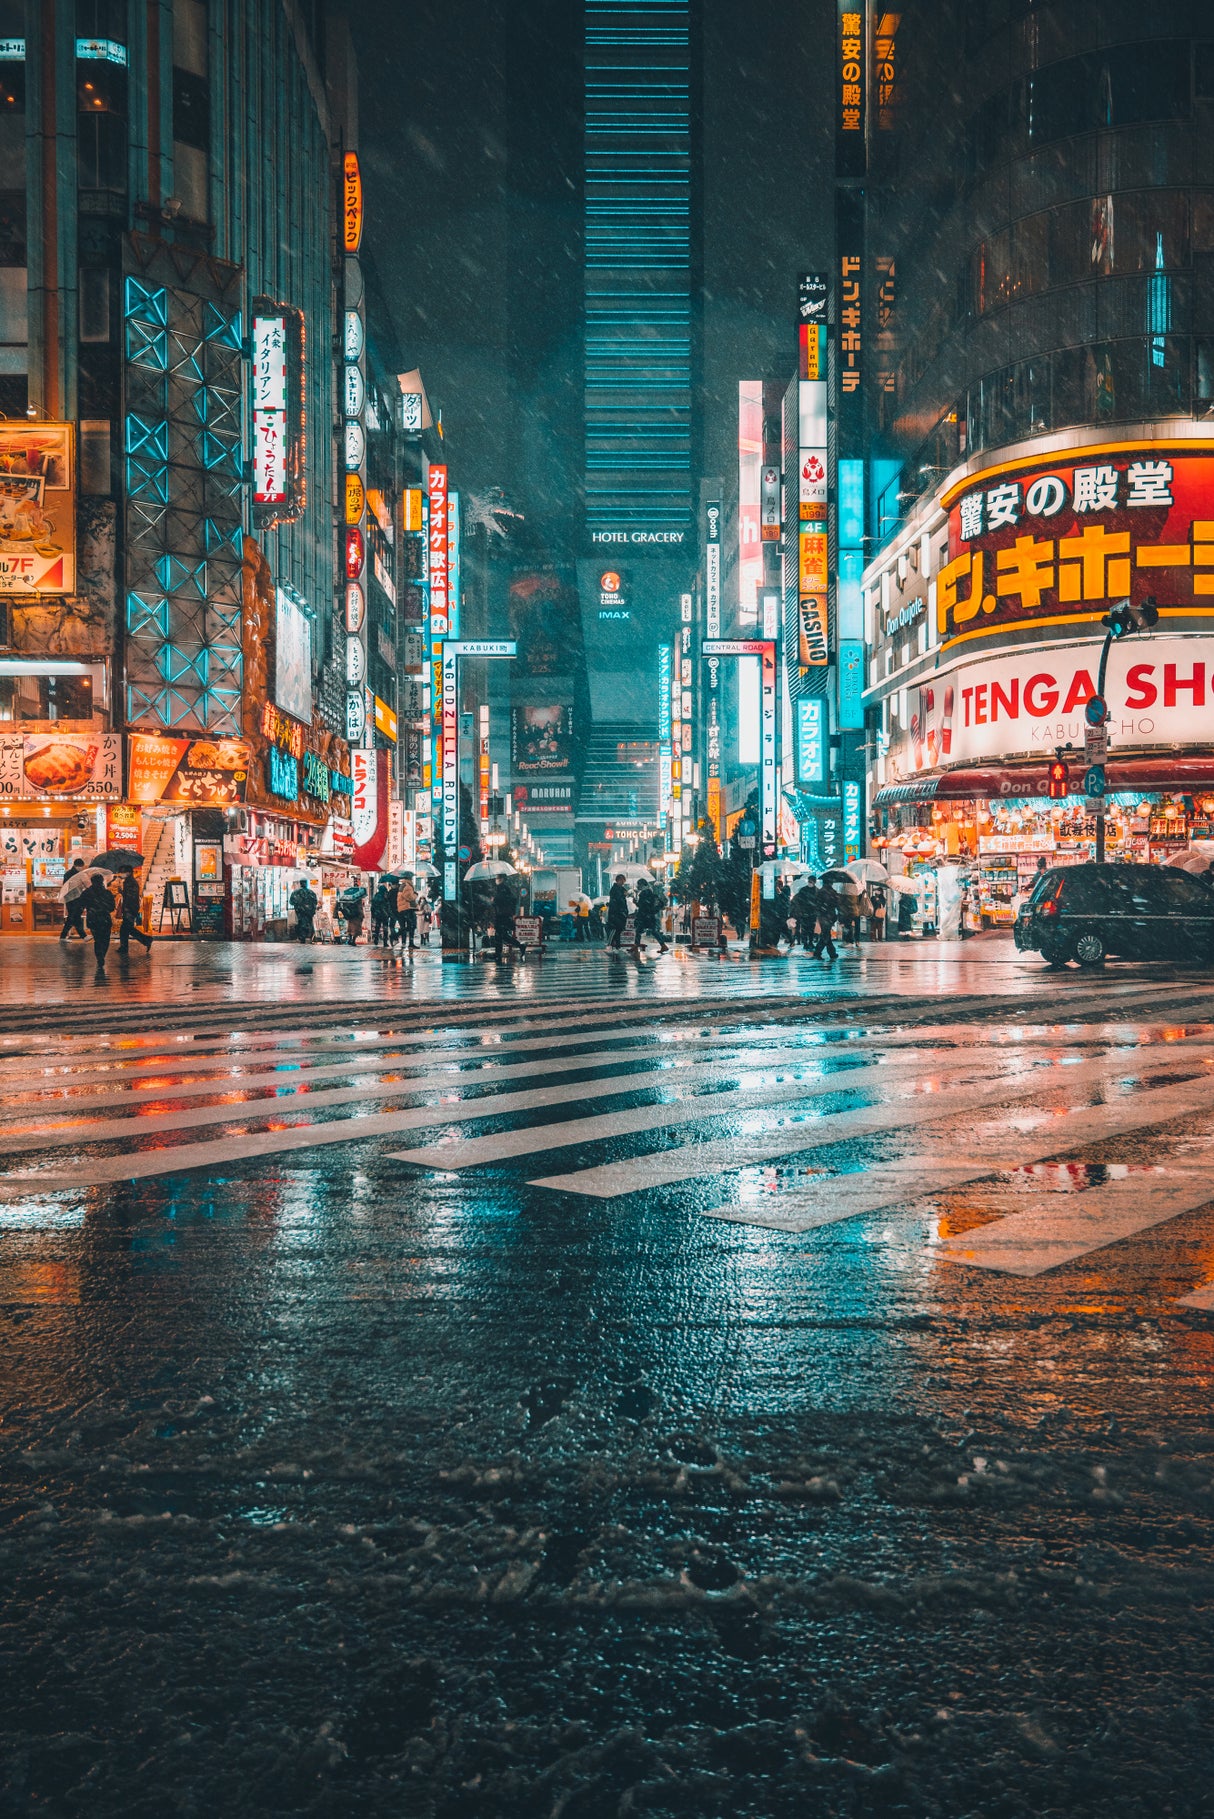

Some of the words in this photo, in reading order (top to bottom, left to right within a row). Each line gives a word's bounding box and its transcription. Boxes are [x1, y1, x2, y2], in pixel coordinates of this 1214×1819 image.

[842, 13, 861, 130] 驚安の殿堂
[260, 333, 271, 401] イタリアン
[260, 426, 277, 492] ひょうたん
[263, 493, 277, 501] 7F
[960, 461, 1174, 542] 驚安の殿堂
[592, 532, 629, 543] HOTEL
[631, 532, 684, 543] GRACERY
[708, 507, 719, 539] Booth
[804, 522, 823, 533] 4F
[804, 537, 824, 575] 麻雀
[599, 611, 630, 619] IMAX
[801, 598, 827, 662] CASINO
[887, 617, 899, 637] Don
[708, 657, 719, 688] Booth
[962, 669, 1100, 727] TENGA
[1124, 662, 1214, 710] SH
[445, 672, 455, 769] GODZILLA
[801, 703, 819, 778] カラオケ
[103, 736, 117, 779] かつ丼
[135, 743, 178, 755] お好み焼き
[87, 780, 119, 794] 550円
[354, 755, 367, 810] トラノコ
[445, 780, 455, 827] ROAD
[1001, 780, 1031, 794] Don
[845, 783, 860, 842] カラオケ
[1060, 822, 1117, 838] 歌舞伎店
[823, 818, 837, 868] カラオケ
